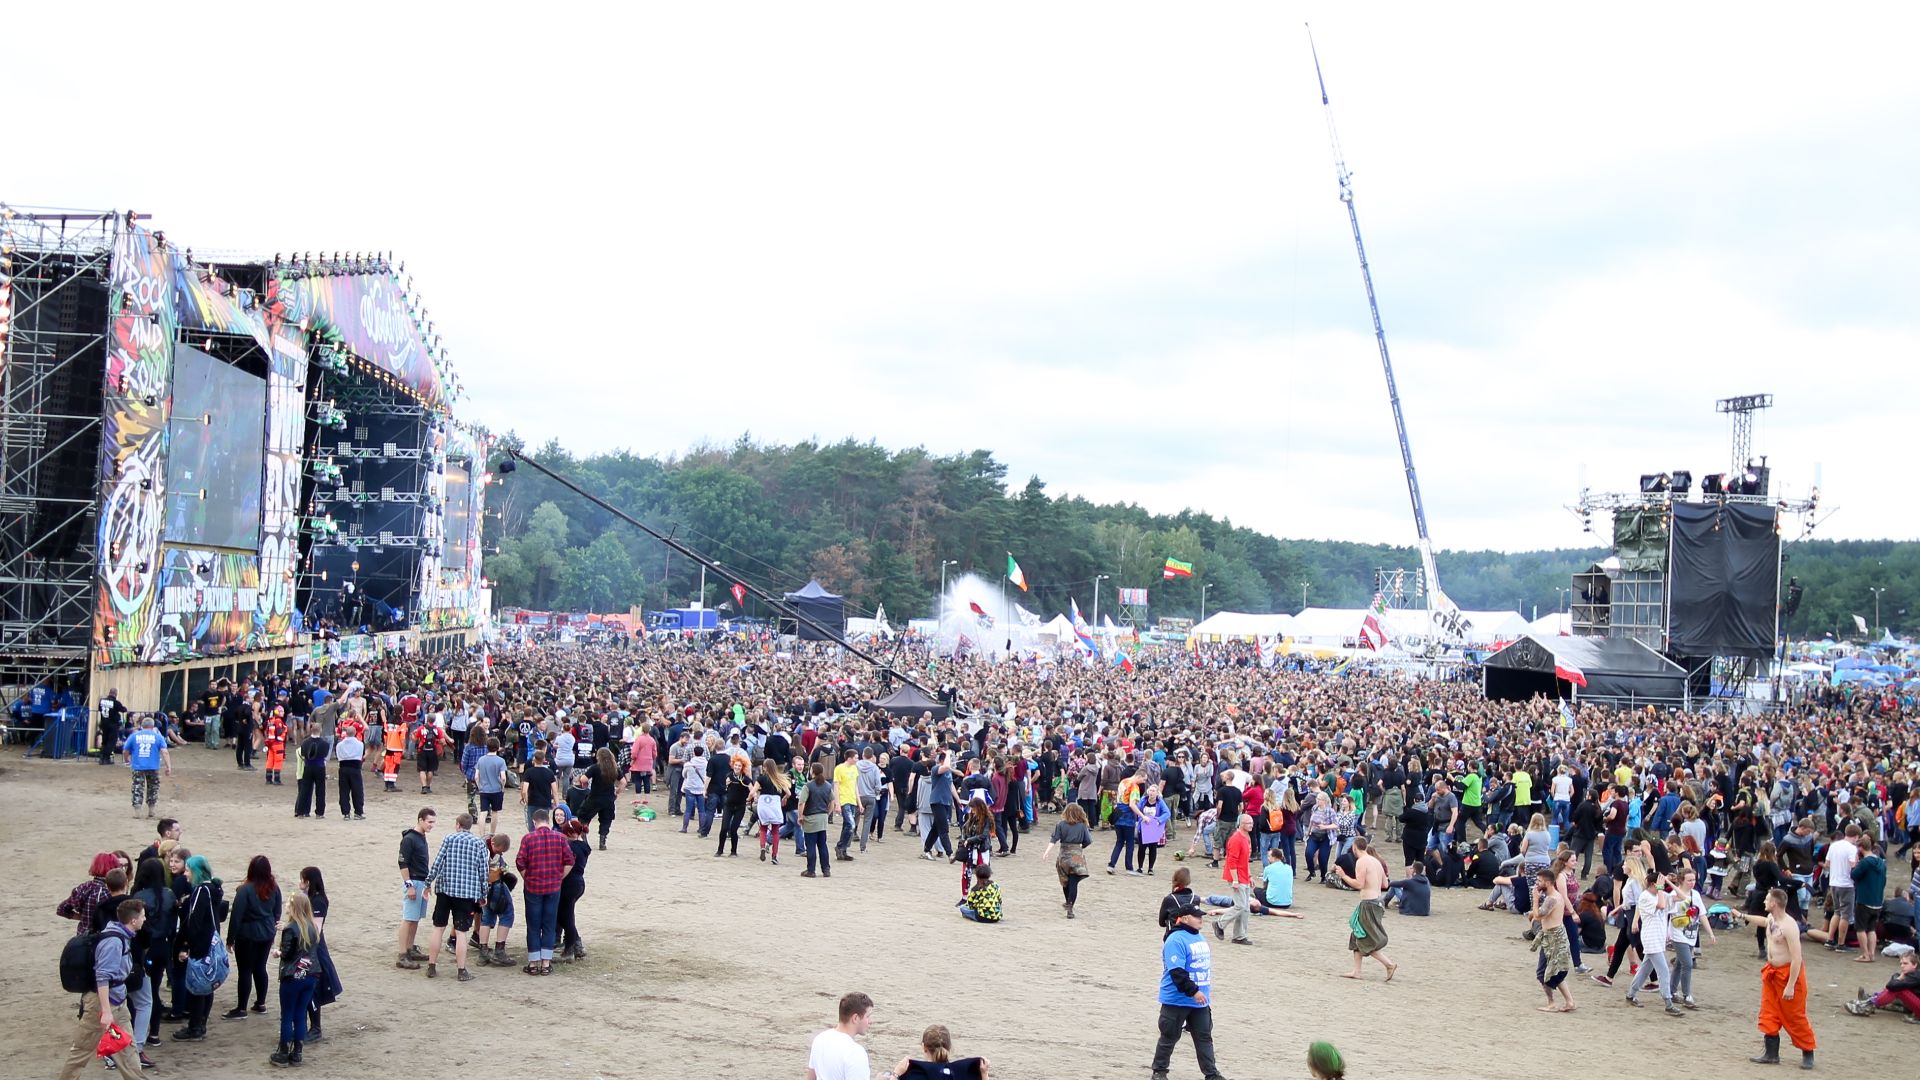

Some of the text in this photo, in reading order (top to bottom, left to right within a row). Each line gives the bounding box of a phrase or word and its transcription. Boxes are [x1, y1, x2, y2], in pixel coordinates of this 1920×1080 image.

[122, 257, 167, 312] ROCK
[129, 316, 163, 350] AND
[1433, 611, 1464, 639] CYRK
